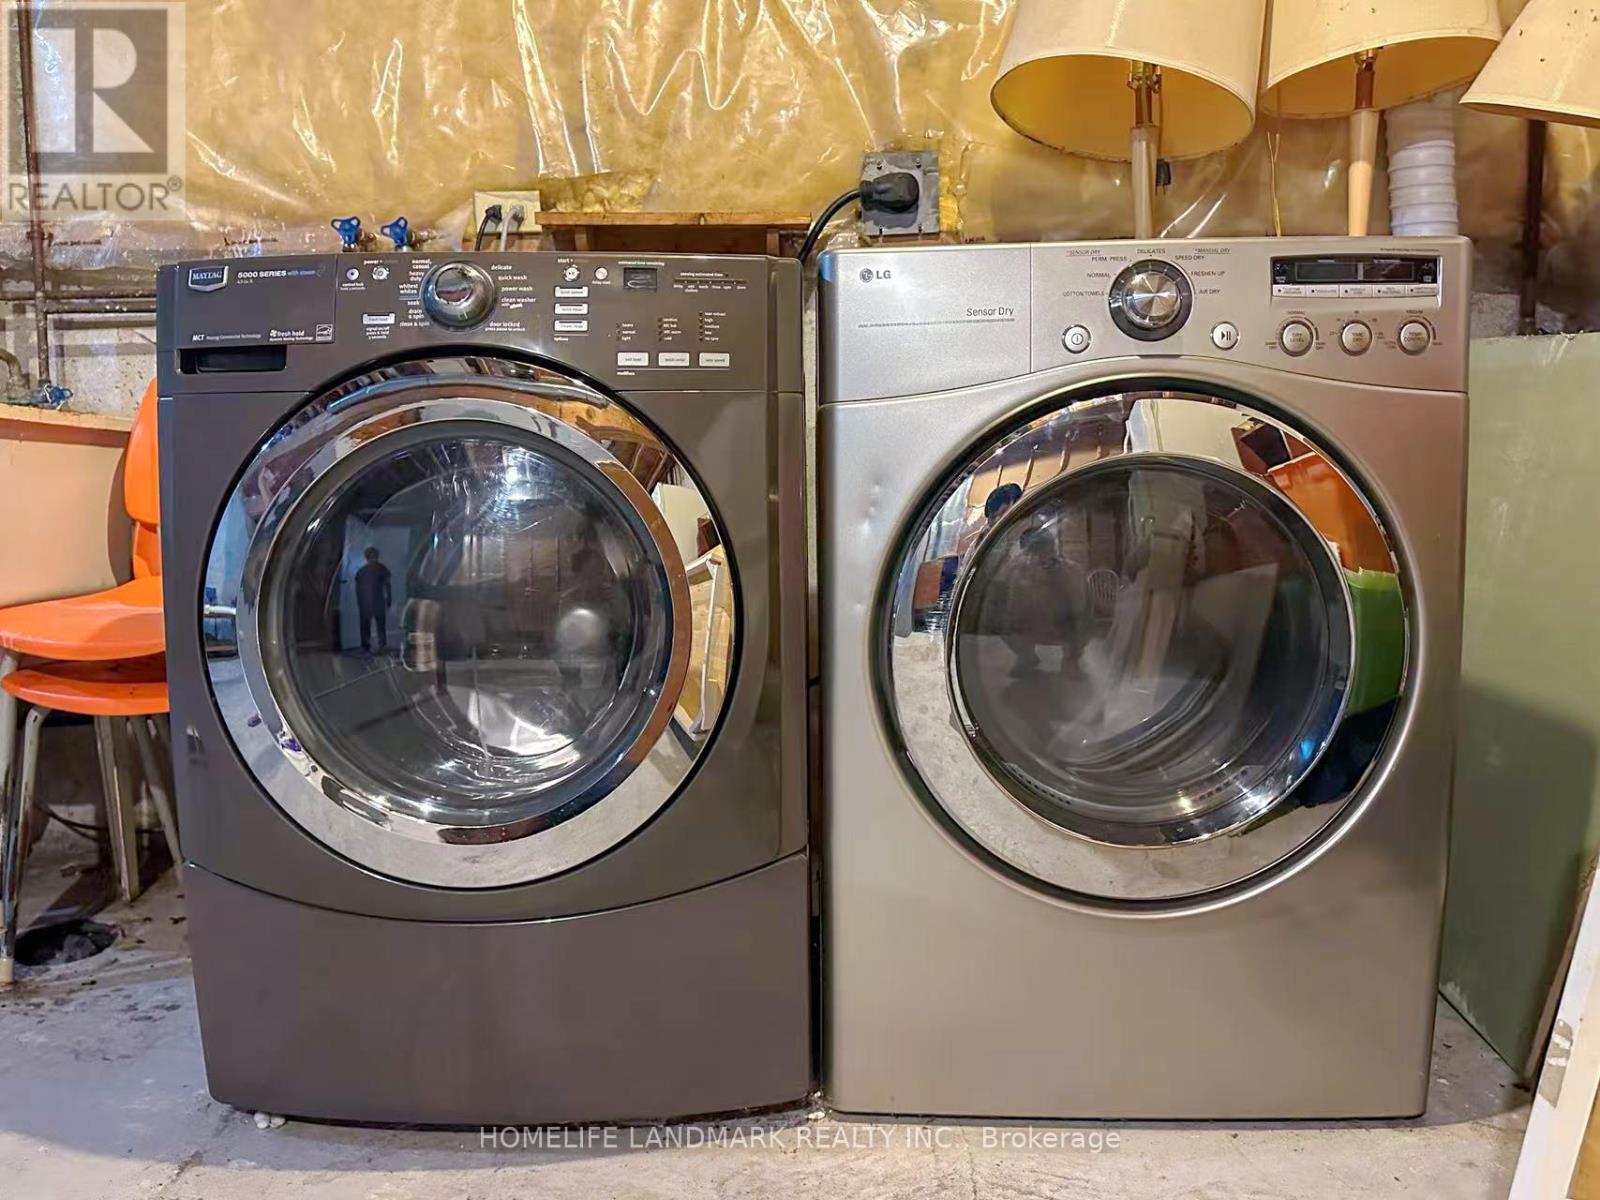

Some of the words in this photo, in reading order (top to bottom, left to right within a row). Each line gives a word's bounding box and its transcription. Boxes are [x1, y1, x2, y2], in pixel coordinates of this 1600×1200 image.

[192, 271, 222, 281] MAYTAG
[237, 271, 258, 279] 5000
[259, 270, 287, 278] SERIES
[876, 270, 891, 280] LG
[966, 307, 997, 317] Sensor
[998, 306, 1015, 316] Dry
